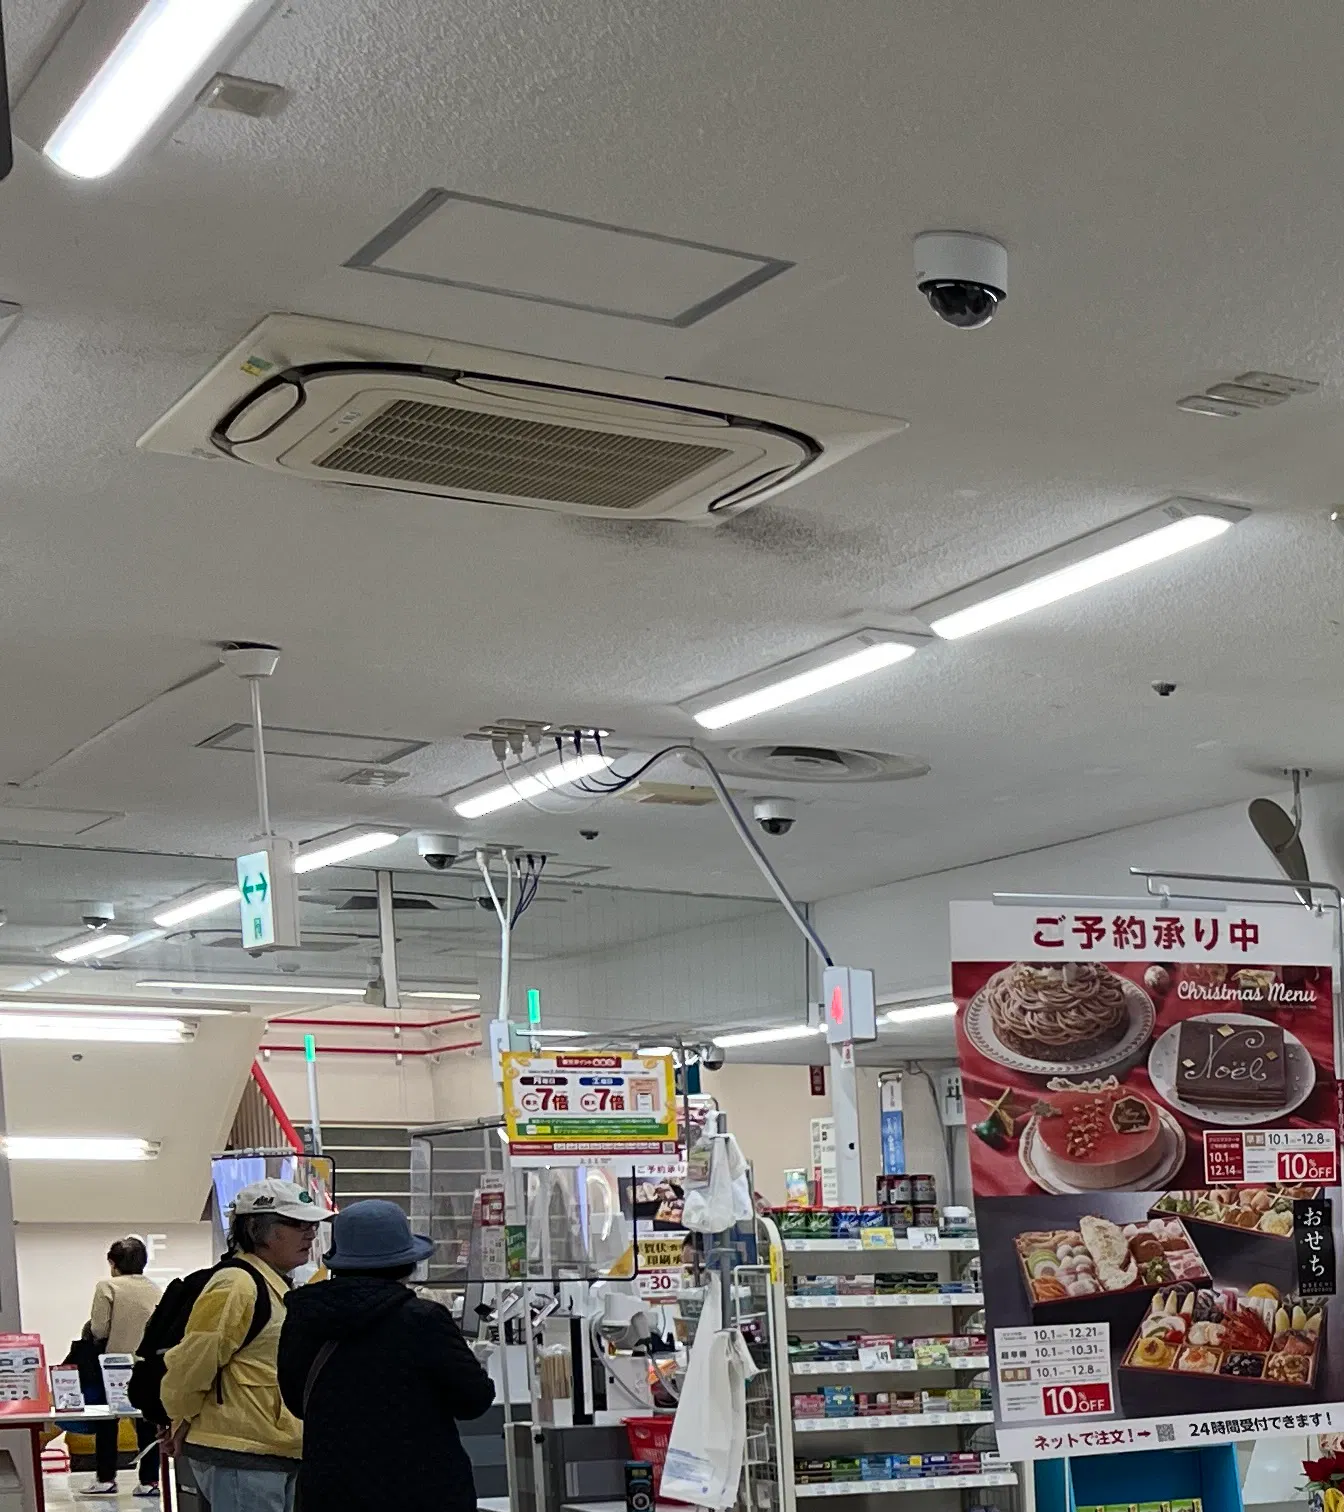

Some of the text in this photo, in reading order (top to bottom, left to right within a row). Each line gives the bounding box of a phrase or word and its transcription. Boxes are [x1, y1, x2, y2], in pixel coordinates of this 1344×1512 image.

[1032, 914, 1260, 953] ご予約承り中
[1177, 980, 1318, 1004] Christmas Menu
[1302, 1207, 1326, 1278] おせち
[1033, 1411, 1333, 1452] ネットで注文！ 24時間受付できます！
